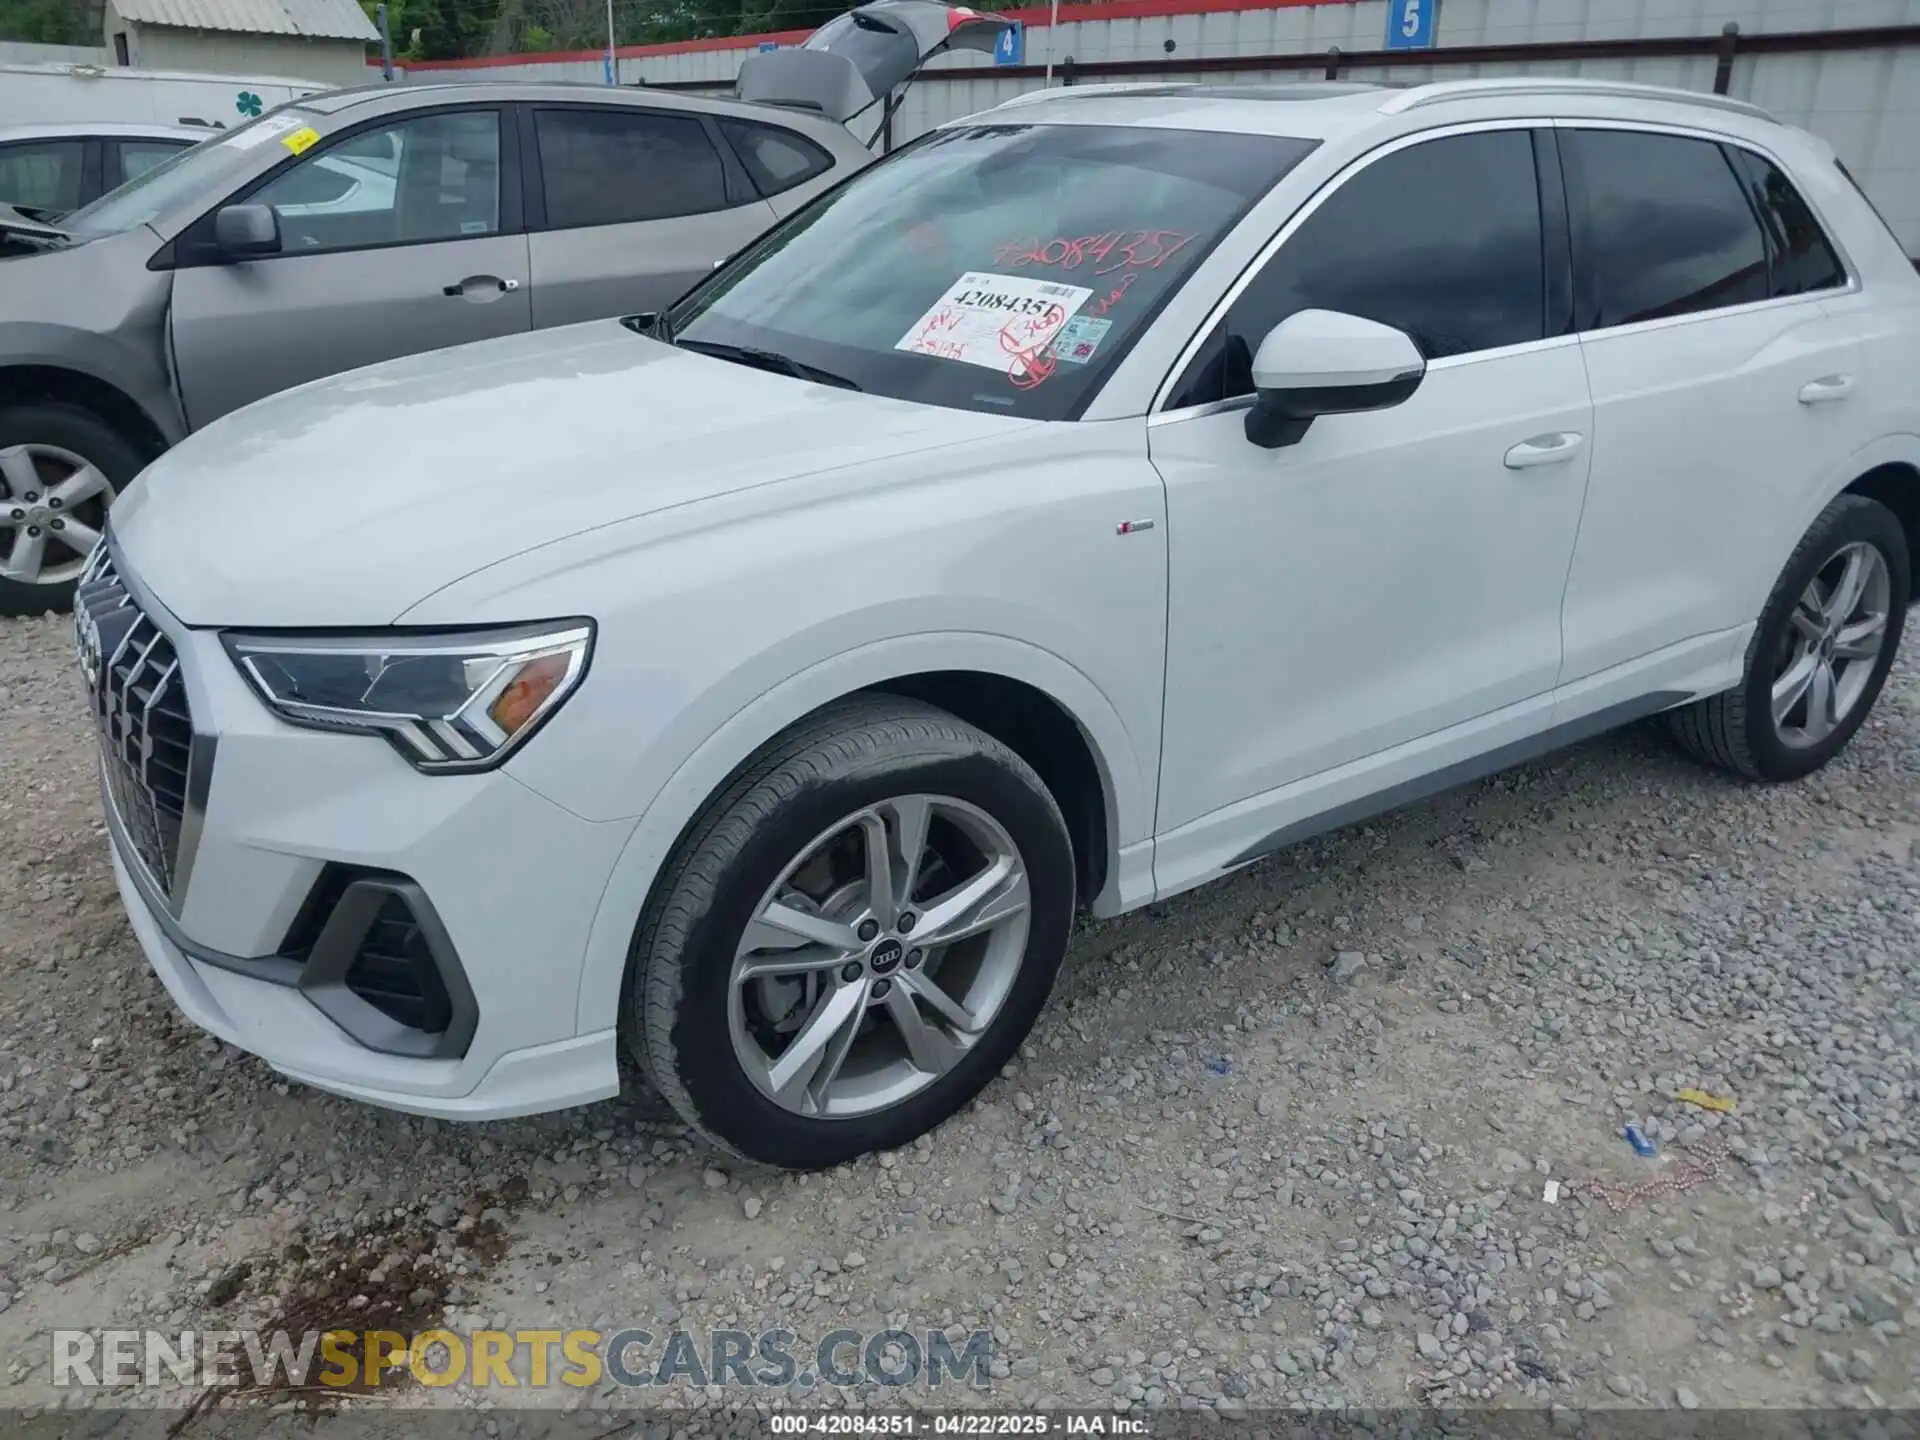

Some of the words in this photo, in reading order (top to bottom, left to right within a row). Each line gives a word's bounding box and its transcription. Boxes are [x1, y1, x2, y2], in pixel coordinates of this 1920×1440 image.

[1402, 0, 1420, 37] 5
[1003, 28, 1013, 56] 4
[954, 290, 1057, 318] 42084351
